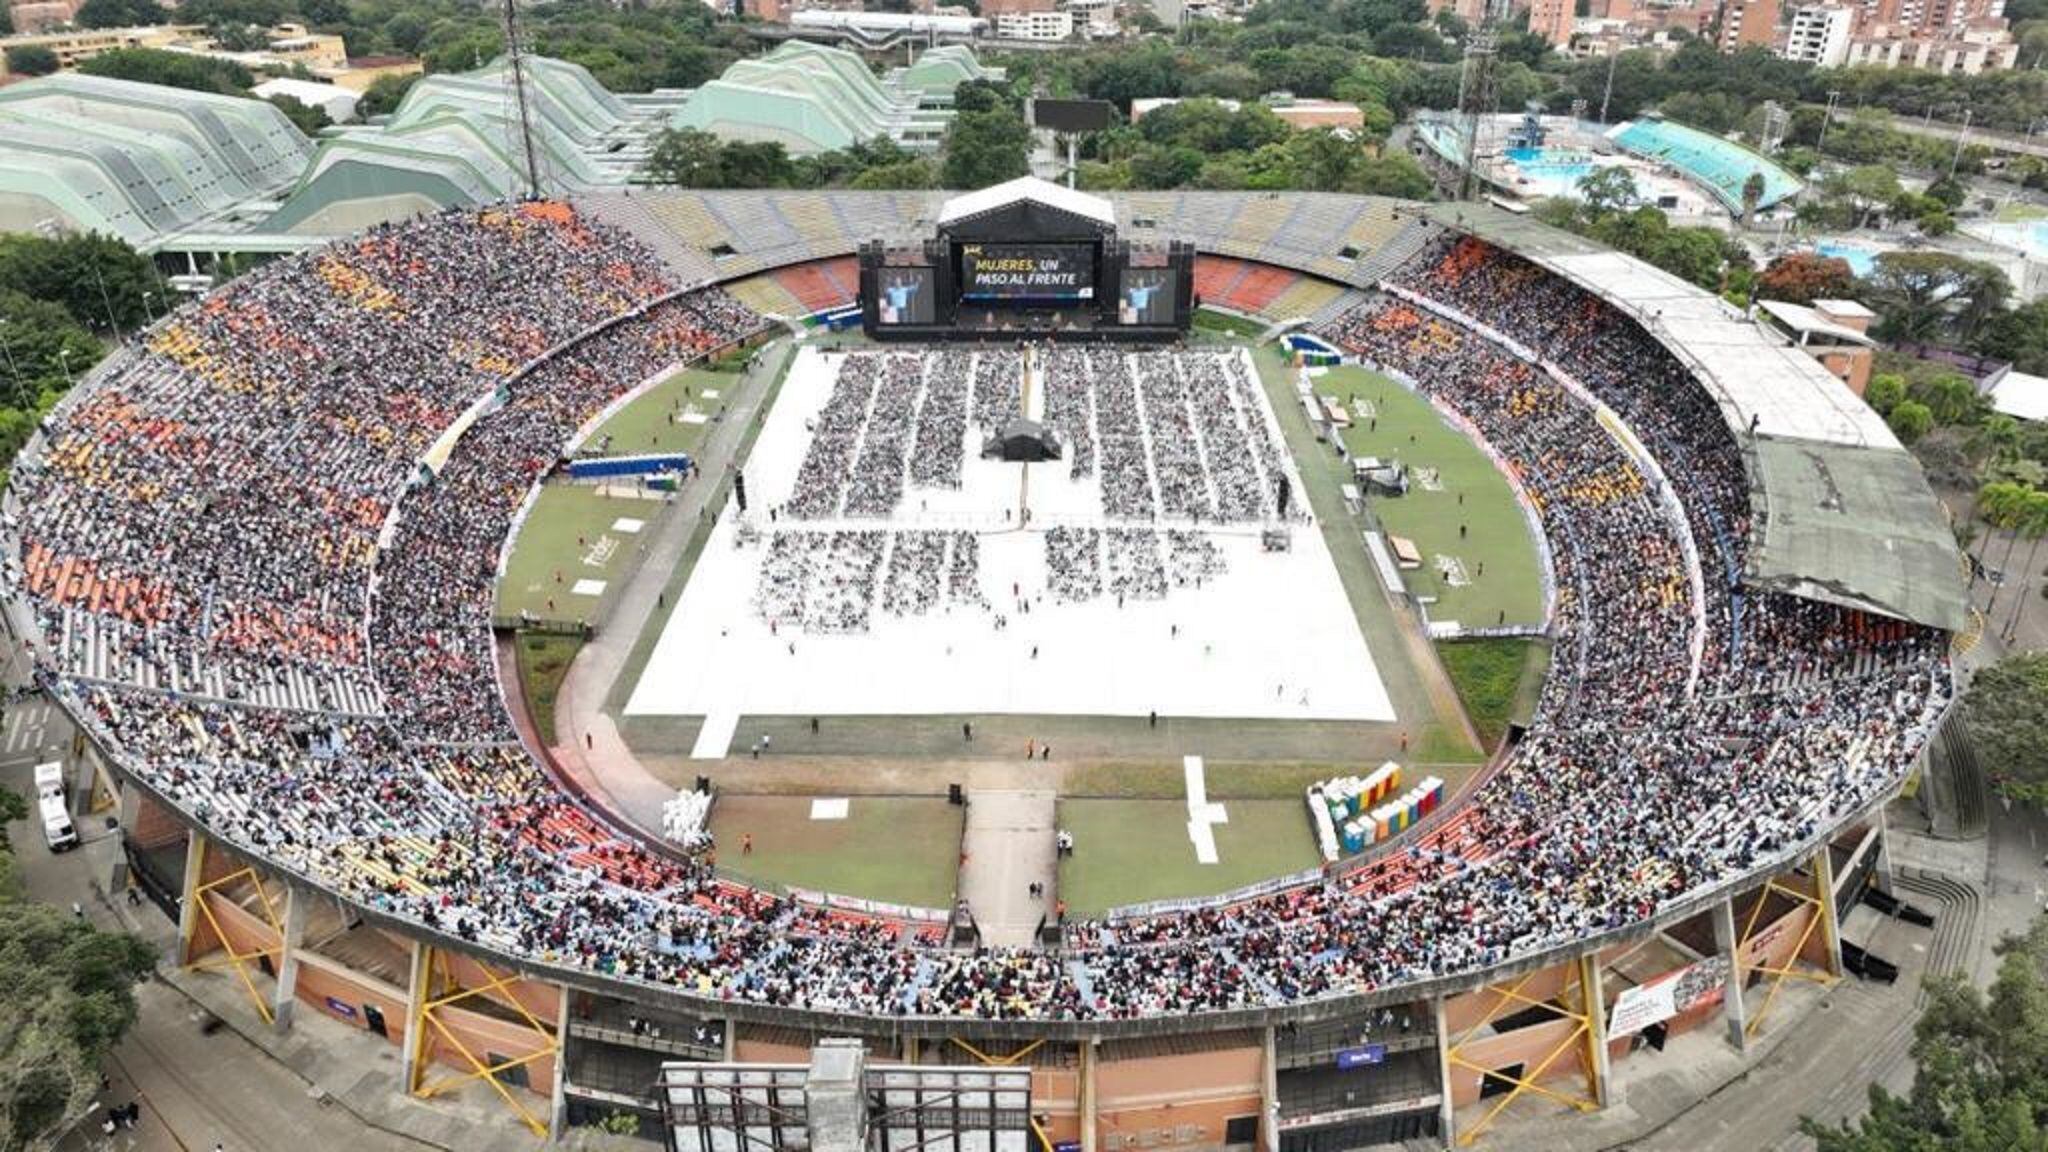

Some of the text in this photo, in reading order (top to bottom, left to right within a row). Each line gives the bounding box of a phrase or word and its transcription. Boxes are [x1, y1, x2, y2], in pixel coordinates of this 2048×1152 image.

[976, 259, 1059, 272] MUJERES, UN
[975, 273, 1076, 286] PASO AL FRENTE
